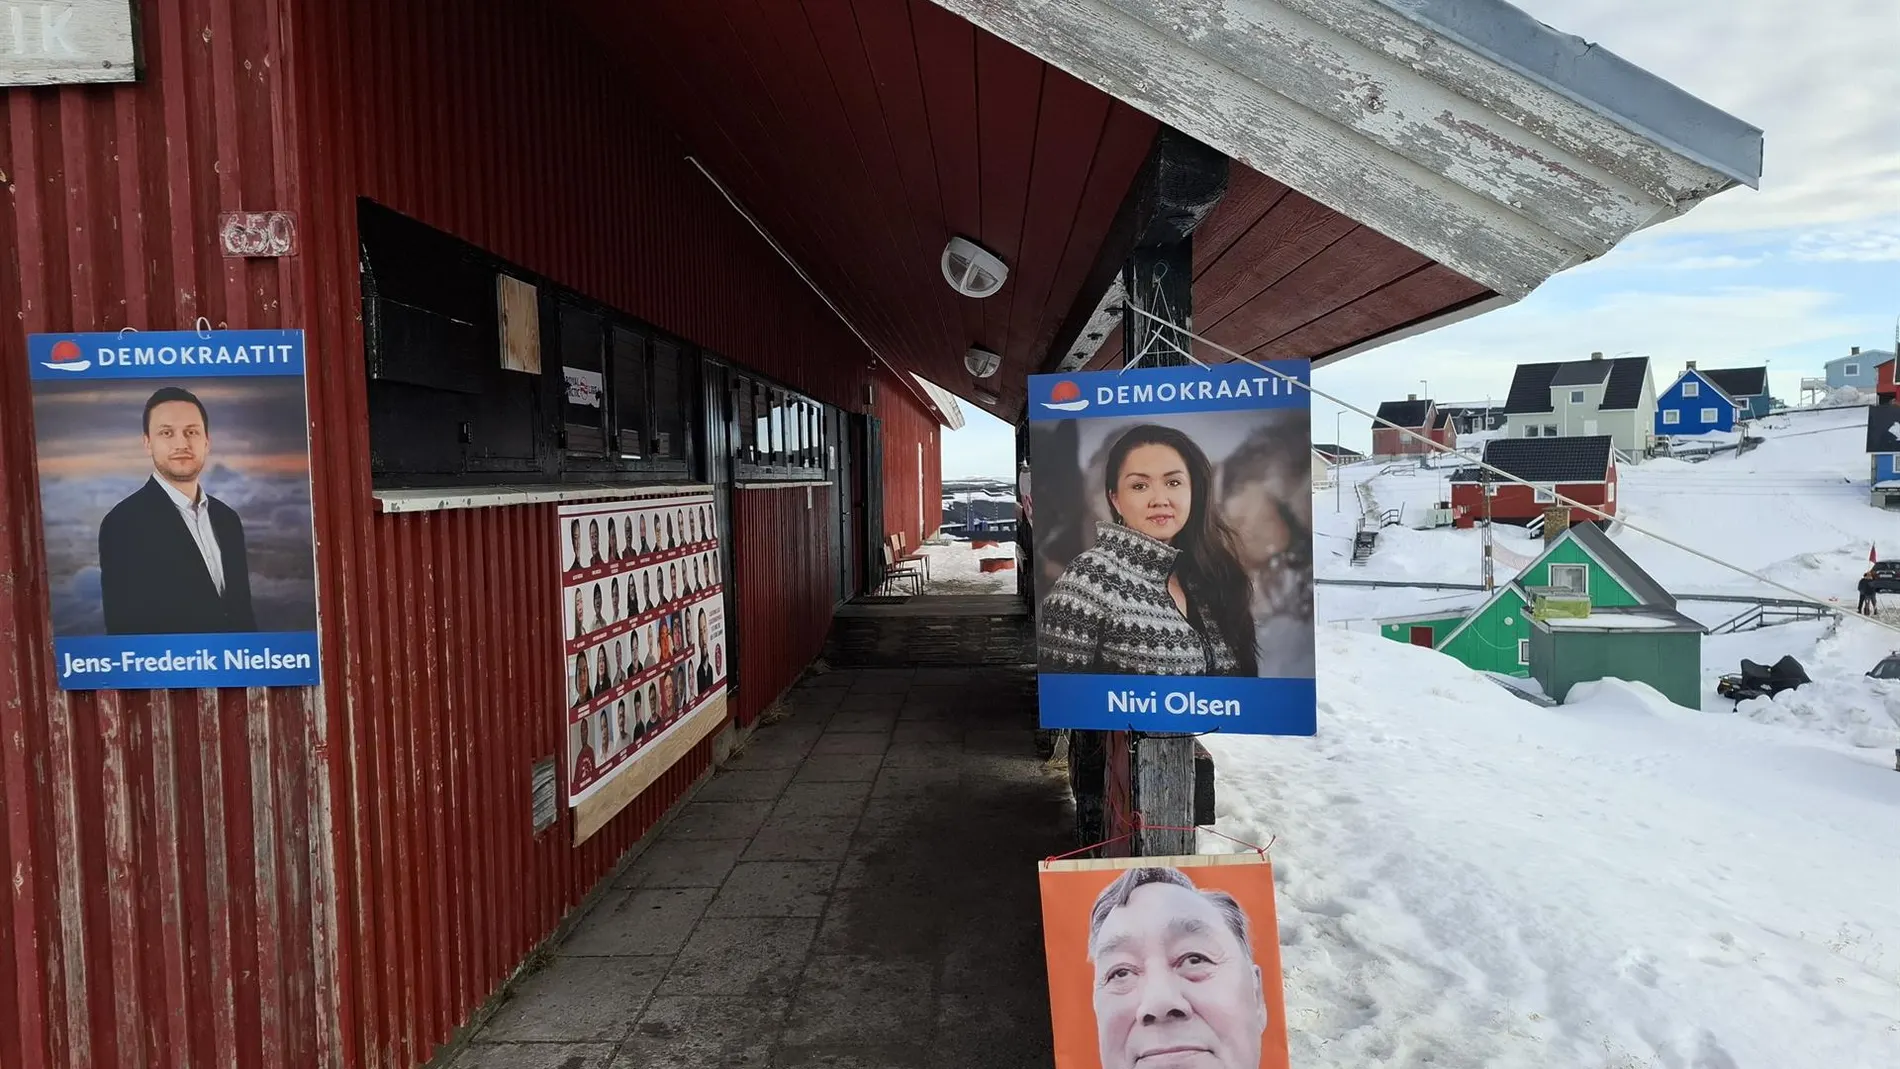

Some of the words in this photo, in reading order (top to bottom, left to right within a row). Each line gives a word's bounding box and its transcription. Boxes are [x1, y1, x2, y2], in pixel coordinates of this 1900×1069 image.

[221, 212, 292, 254] 650
[98, 344, 293, 367] DEMOKRAATIT
[1096, 375, 1298, 406] DEMOKRAATIT
[63, 649, 217, 678] Jens-Frederik
[224, 647, 311, 671] Nielsen
[1107, 690, 1157, 714] Nivi
[1164, 691, 1241, 717] Olsen
